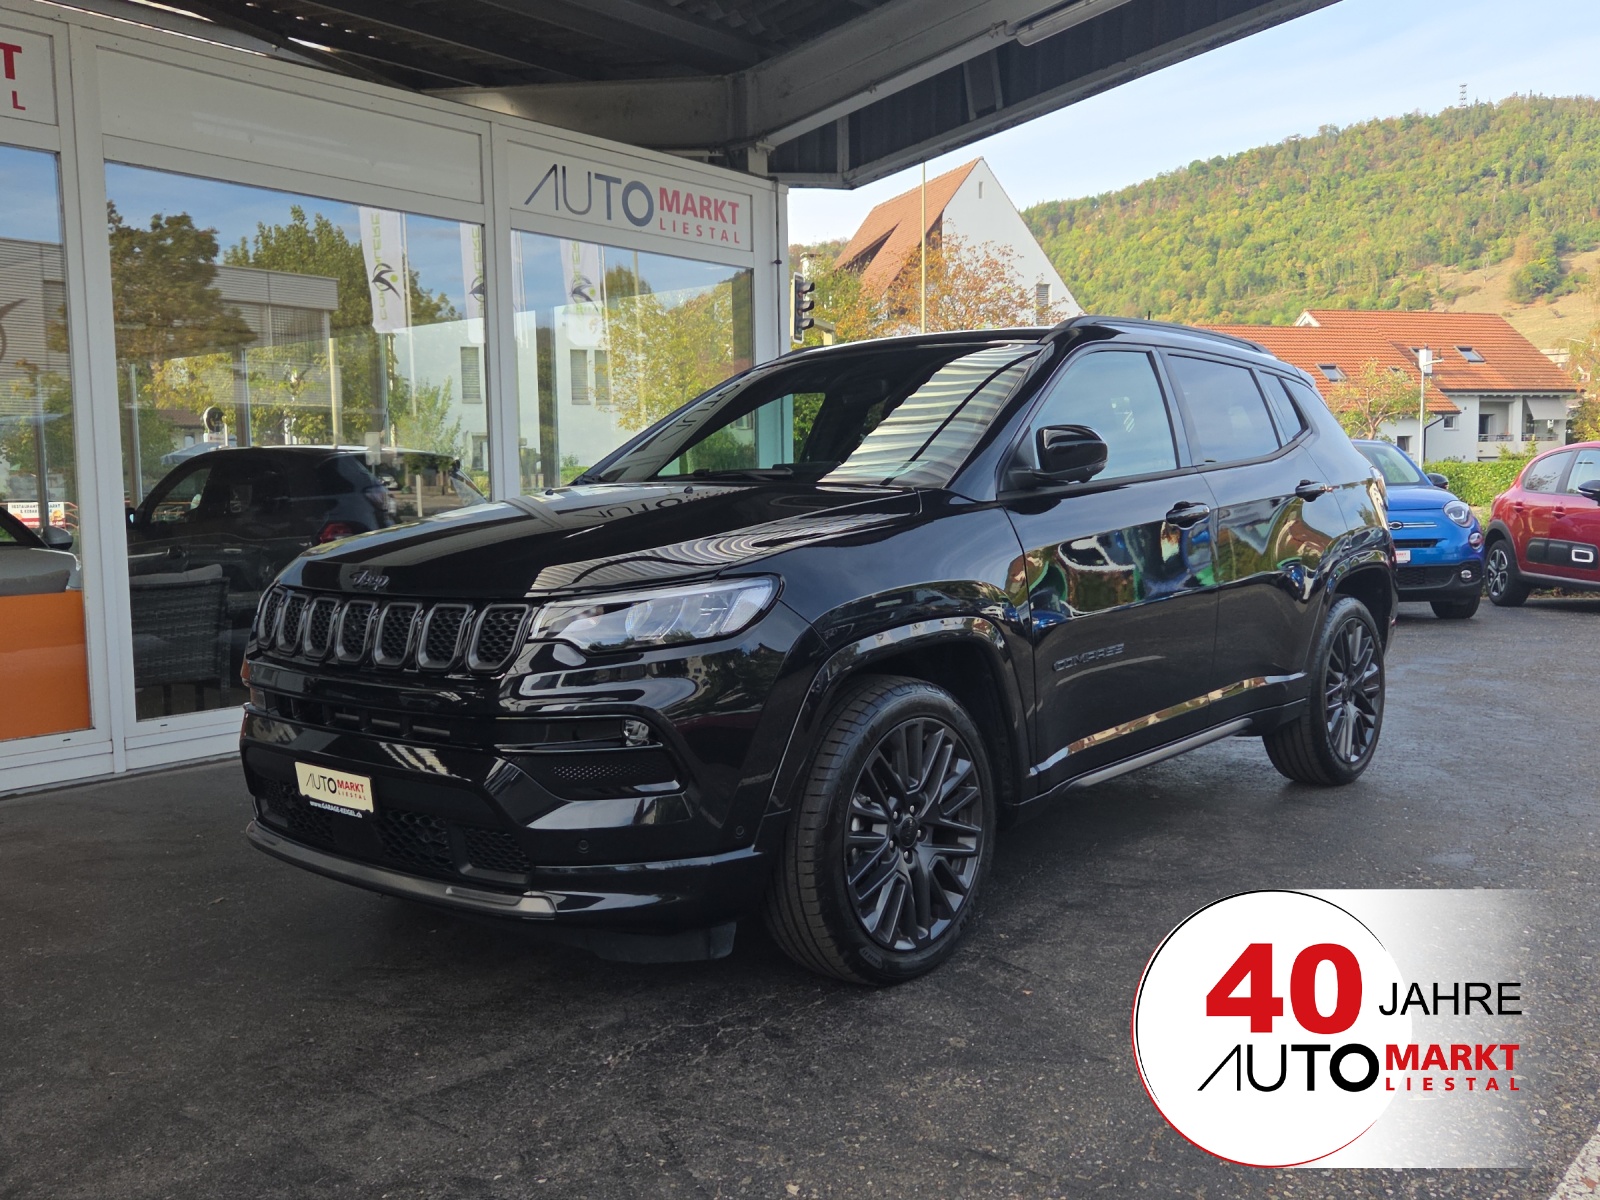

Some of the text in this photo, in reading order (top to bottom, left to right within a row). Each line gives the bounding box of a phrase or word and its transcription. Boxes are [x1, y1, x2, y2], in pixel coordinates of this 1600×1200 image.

[524, 163, 740, 227] AUTO MARKT
[659, 217, 740, 245] LIESTAL
[350, 570, 390, 591] Jeep
[1053, 643, 1125, 672] COMPASS
[306, 773, 364, 794] AUTO MARKT
